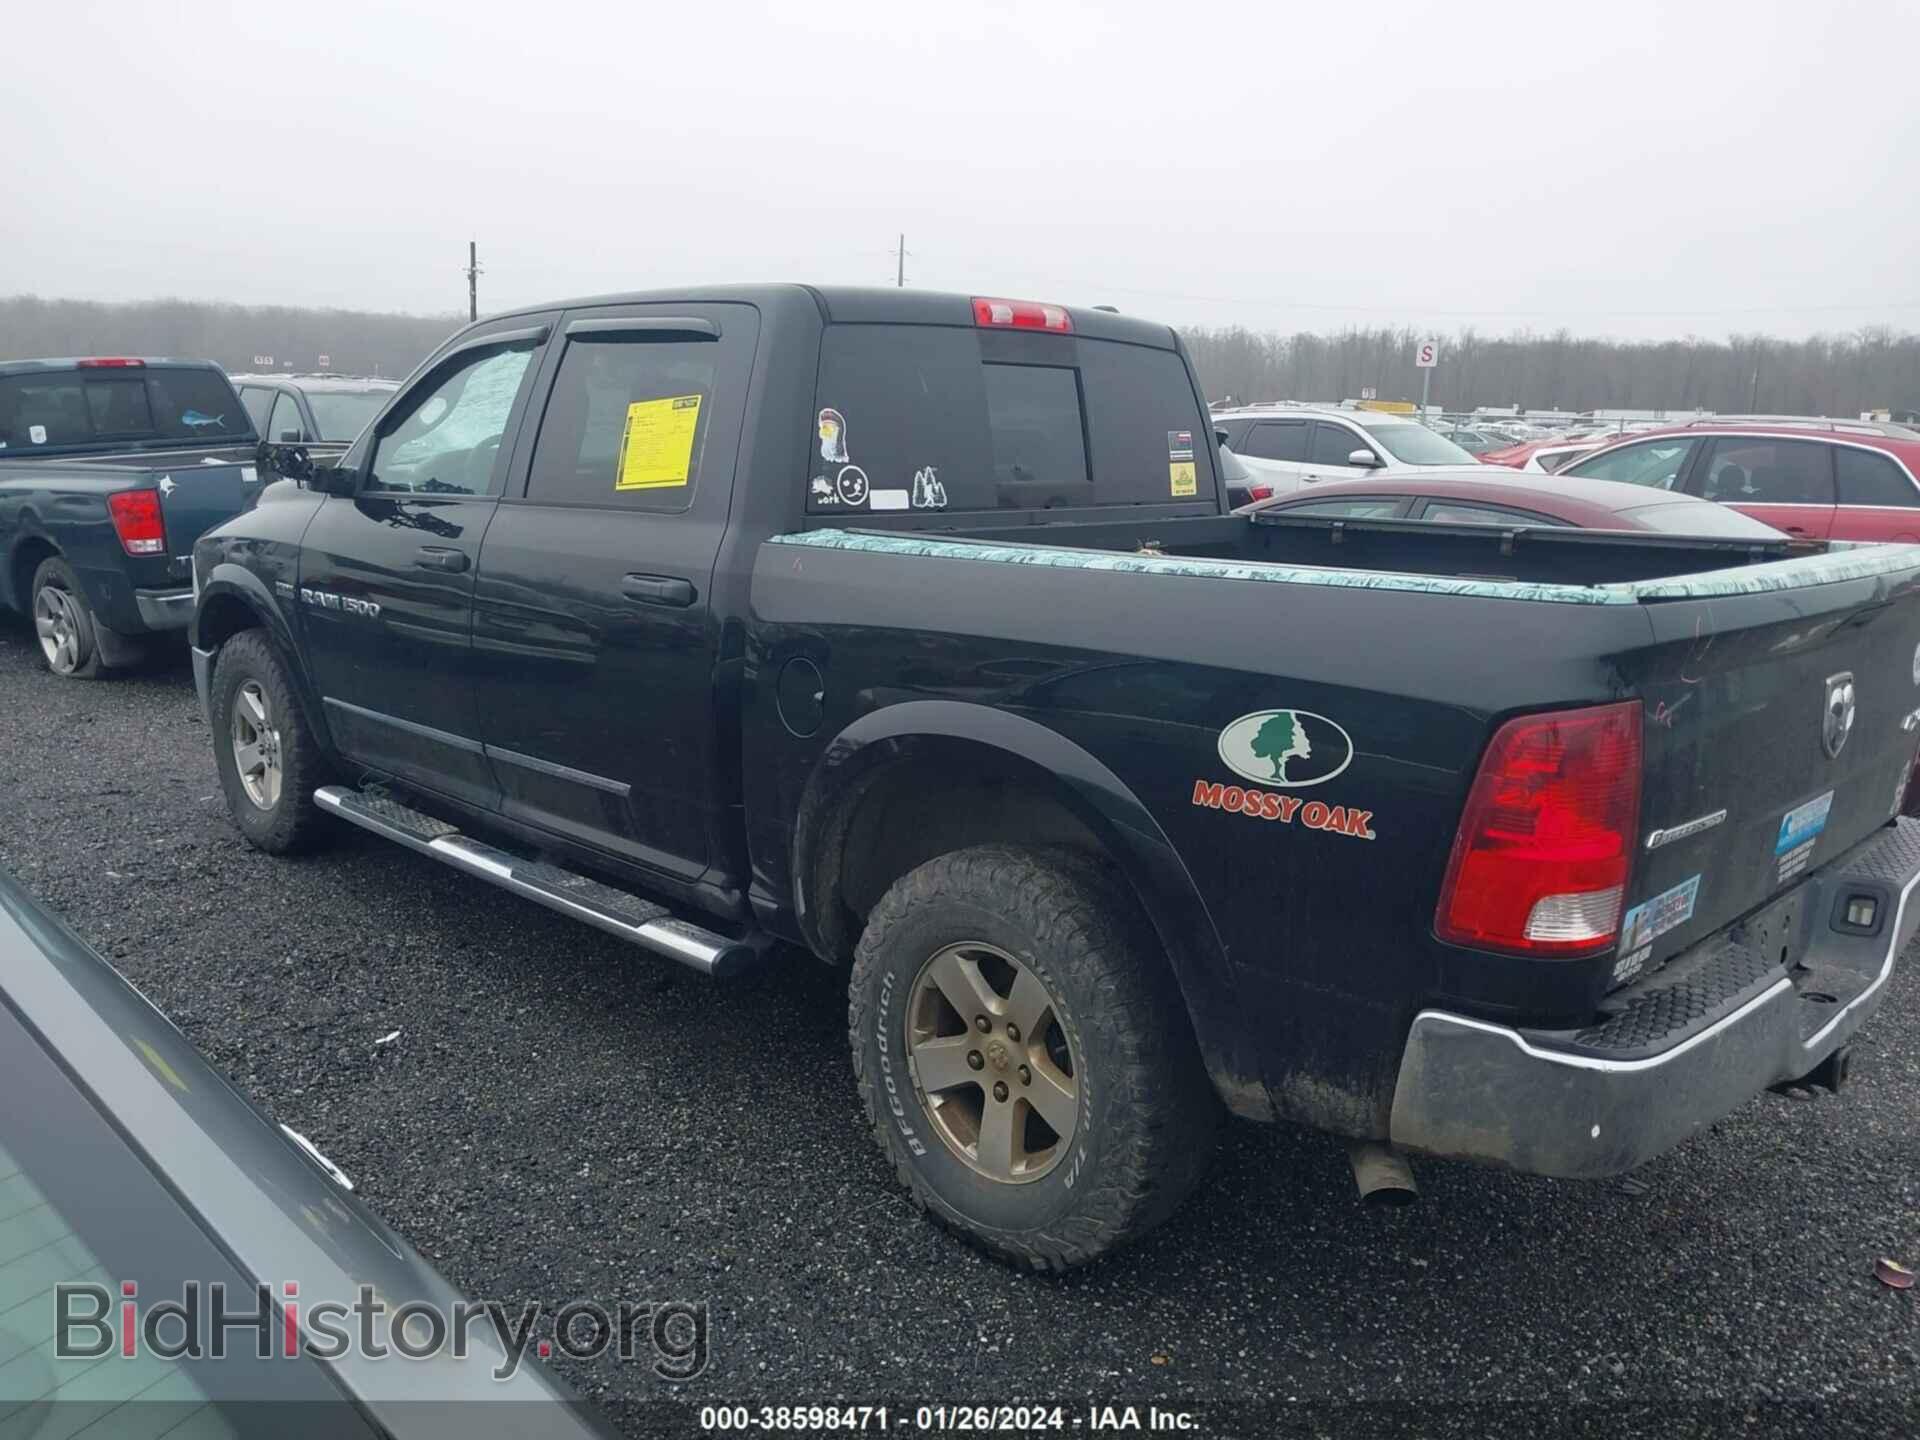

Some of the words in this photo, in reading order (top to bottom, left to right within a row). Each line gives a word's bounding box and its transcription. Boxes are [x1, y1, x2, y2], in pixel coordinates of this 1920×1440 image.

[1421, 345, 1433, 362] S
[341, 597, 381, 617] 1500
[1193, 780, 1302, 823] MOSSY
[1301, 802, 1373, 839] OAK
[876, 971, 927, 1156] BFGoodrich
